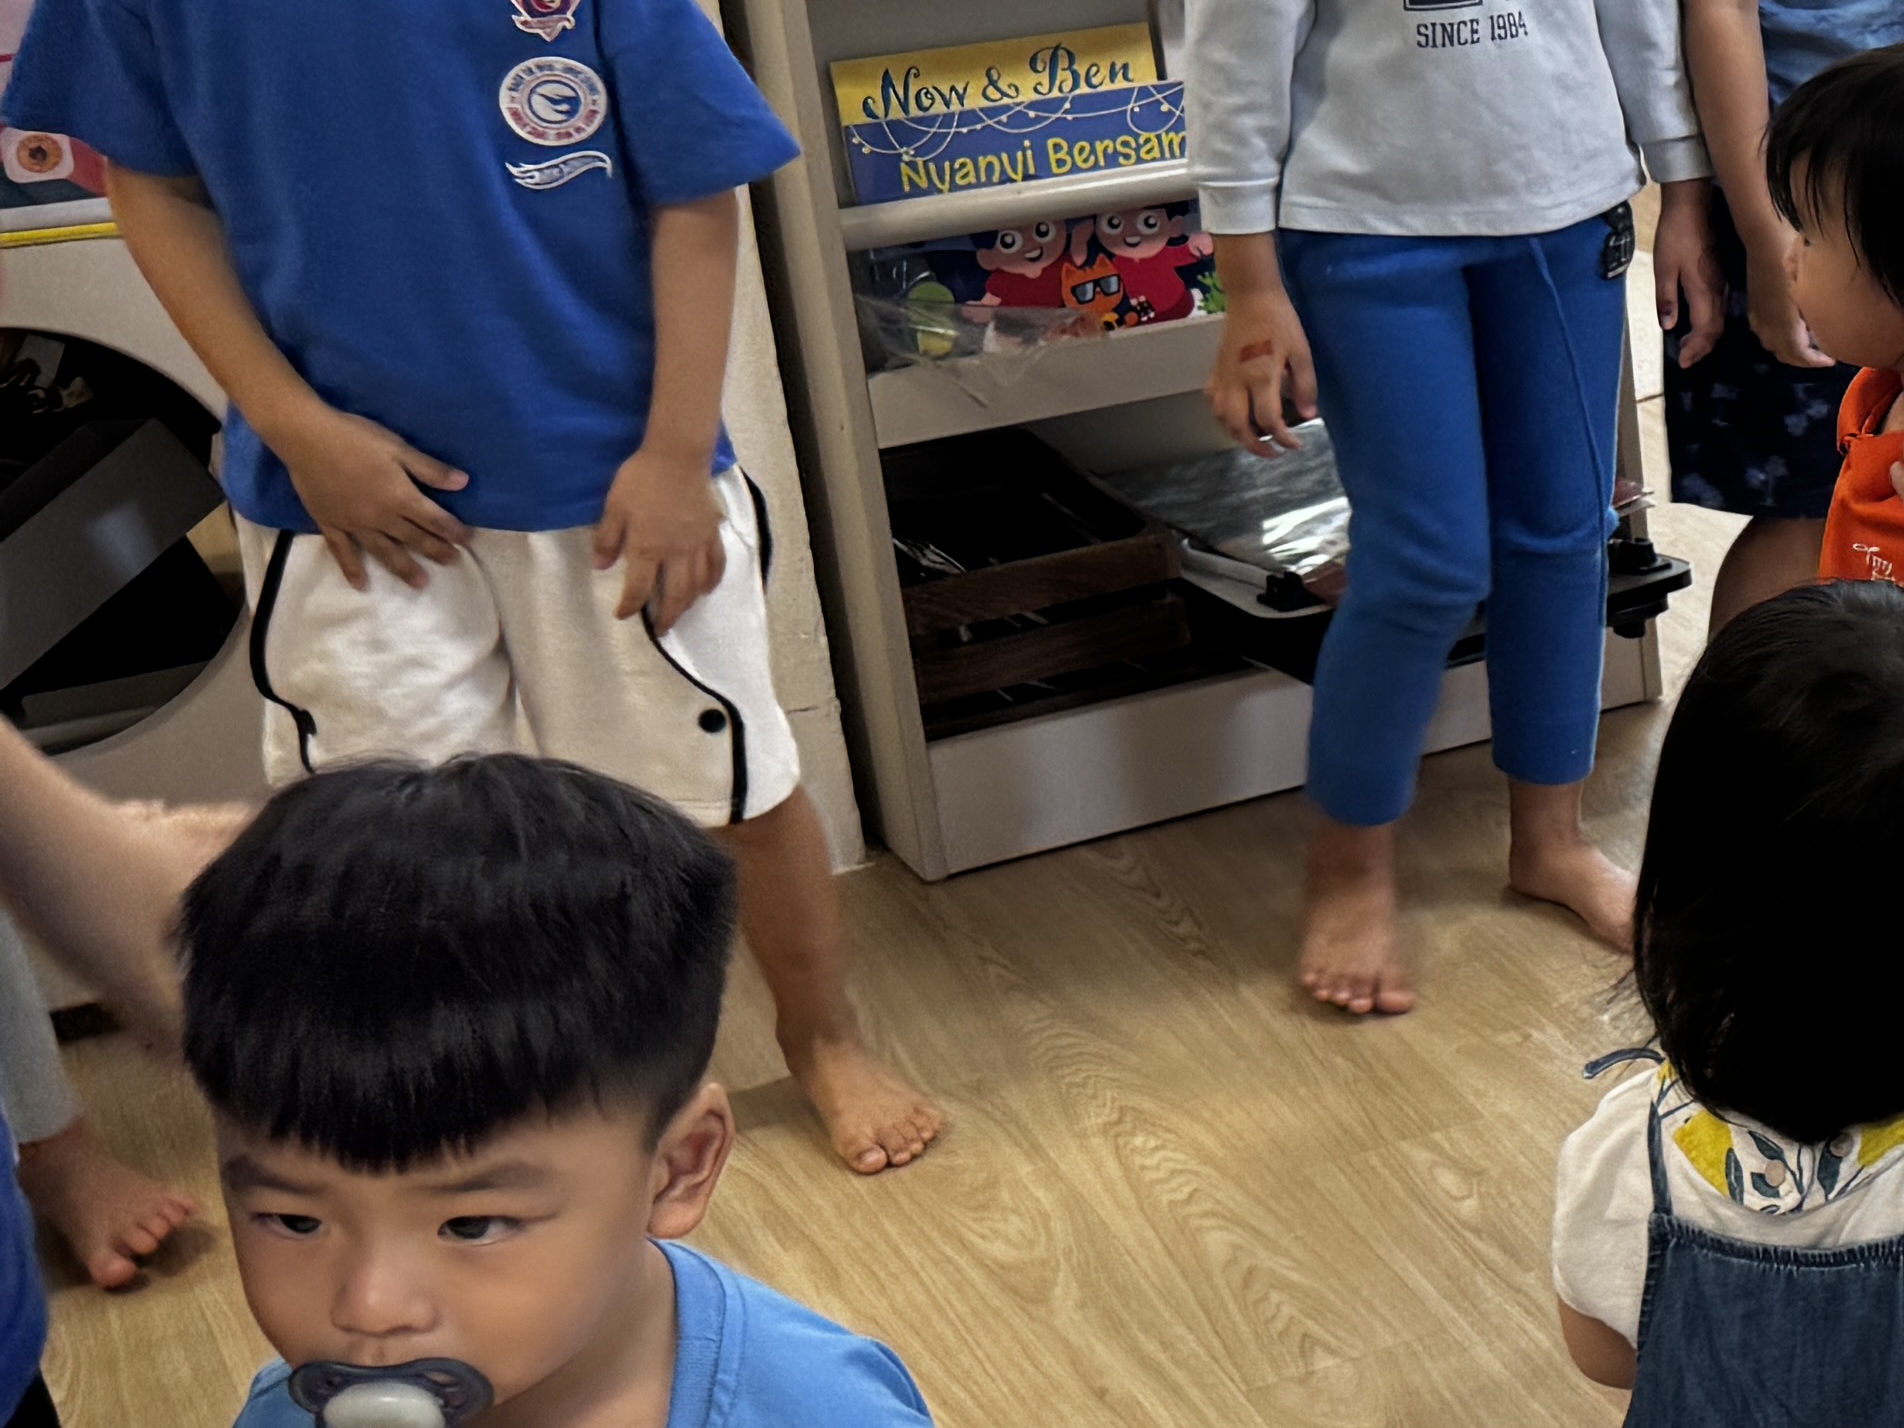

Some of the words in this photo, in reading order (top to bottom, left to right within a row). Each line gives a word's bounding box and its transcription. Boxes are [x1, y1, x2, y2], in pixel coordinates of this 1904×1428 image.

[1416, 18, 1482, 49] SINCE
[862, 65, 970, 121] Now
[981, 65, 1021, 104] &
[1028, 42, 1135, 97] Ben
[900, 139, 1037, 194] Nyanyi
[1047, 130, 1188, 175] Bersam
